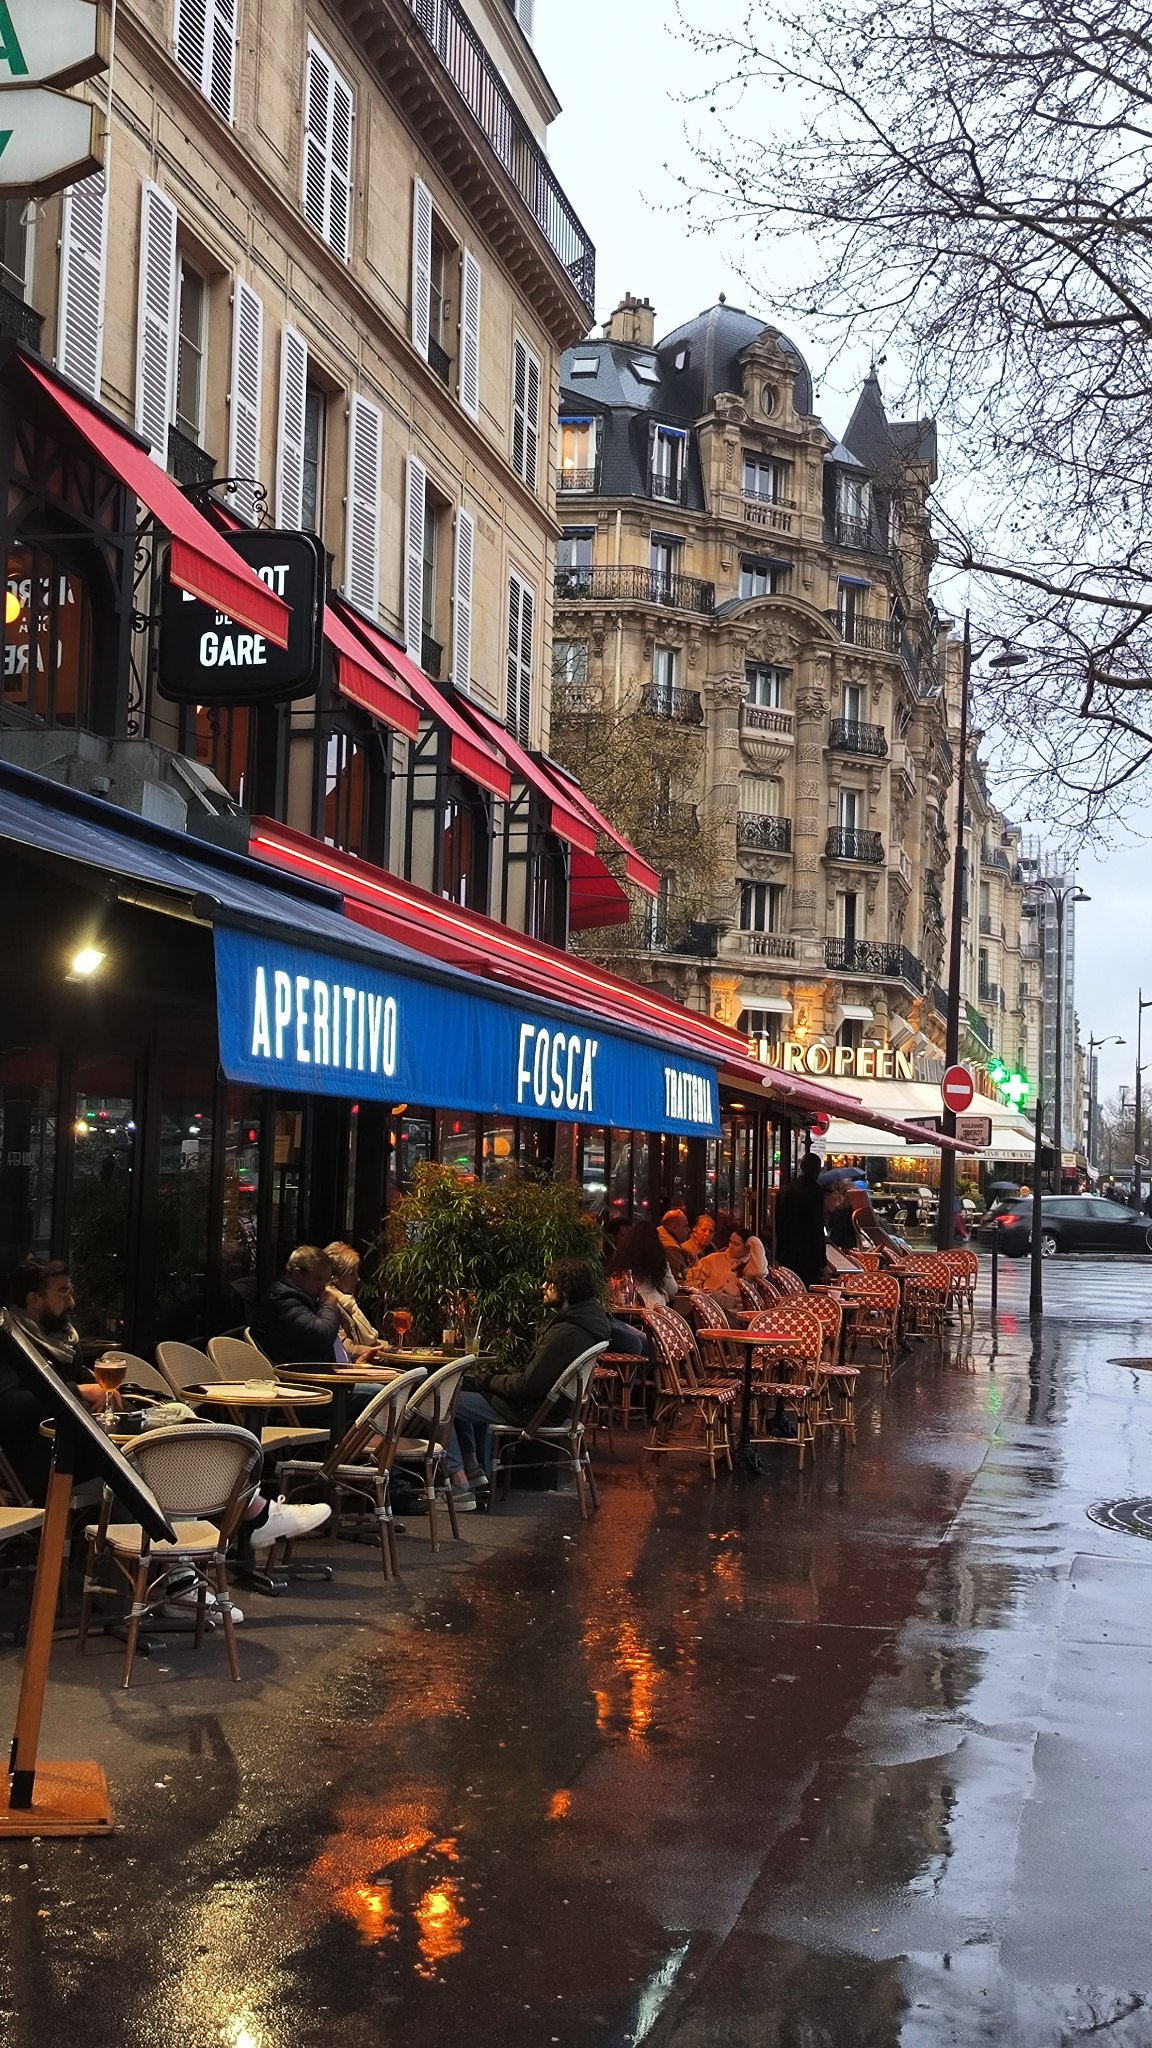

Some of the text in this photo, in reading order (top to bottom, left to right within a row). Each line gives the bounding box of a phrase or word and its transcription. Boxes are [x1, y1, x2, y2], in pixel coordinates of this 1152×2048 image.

[200, 631, 267, 667] GARE
[251, 966, 397, 1077] APERITIVO
[664, 1067, 713, 1124] TRATTORIA
